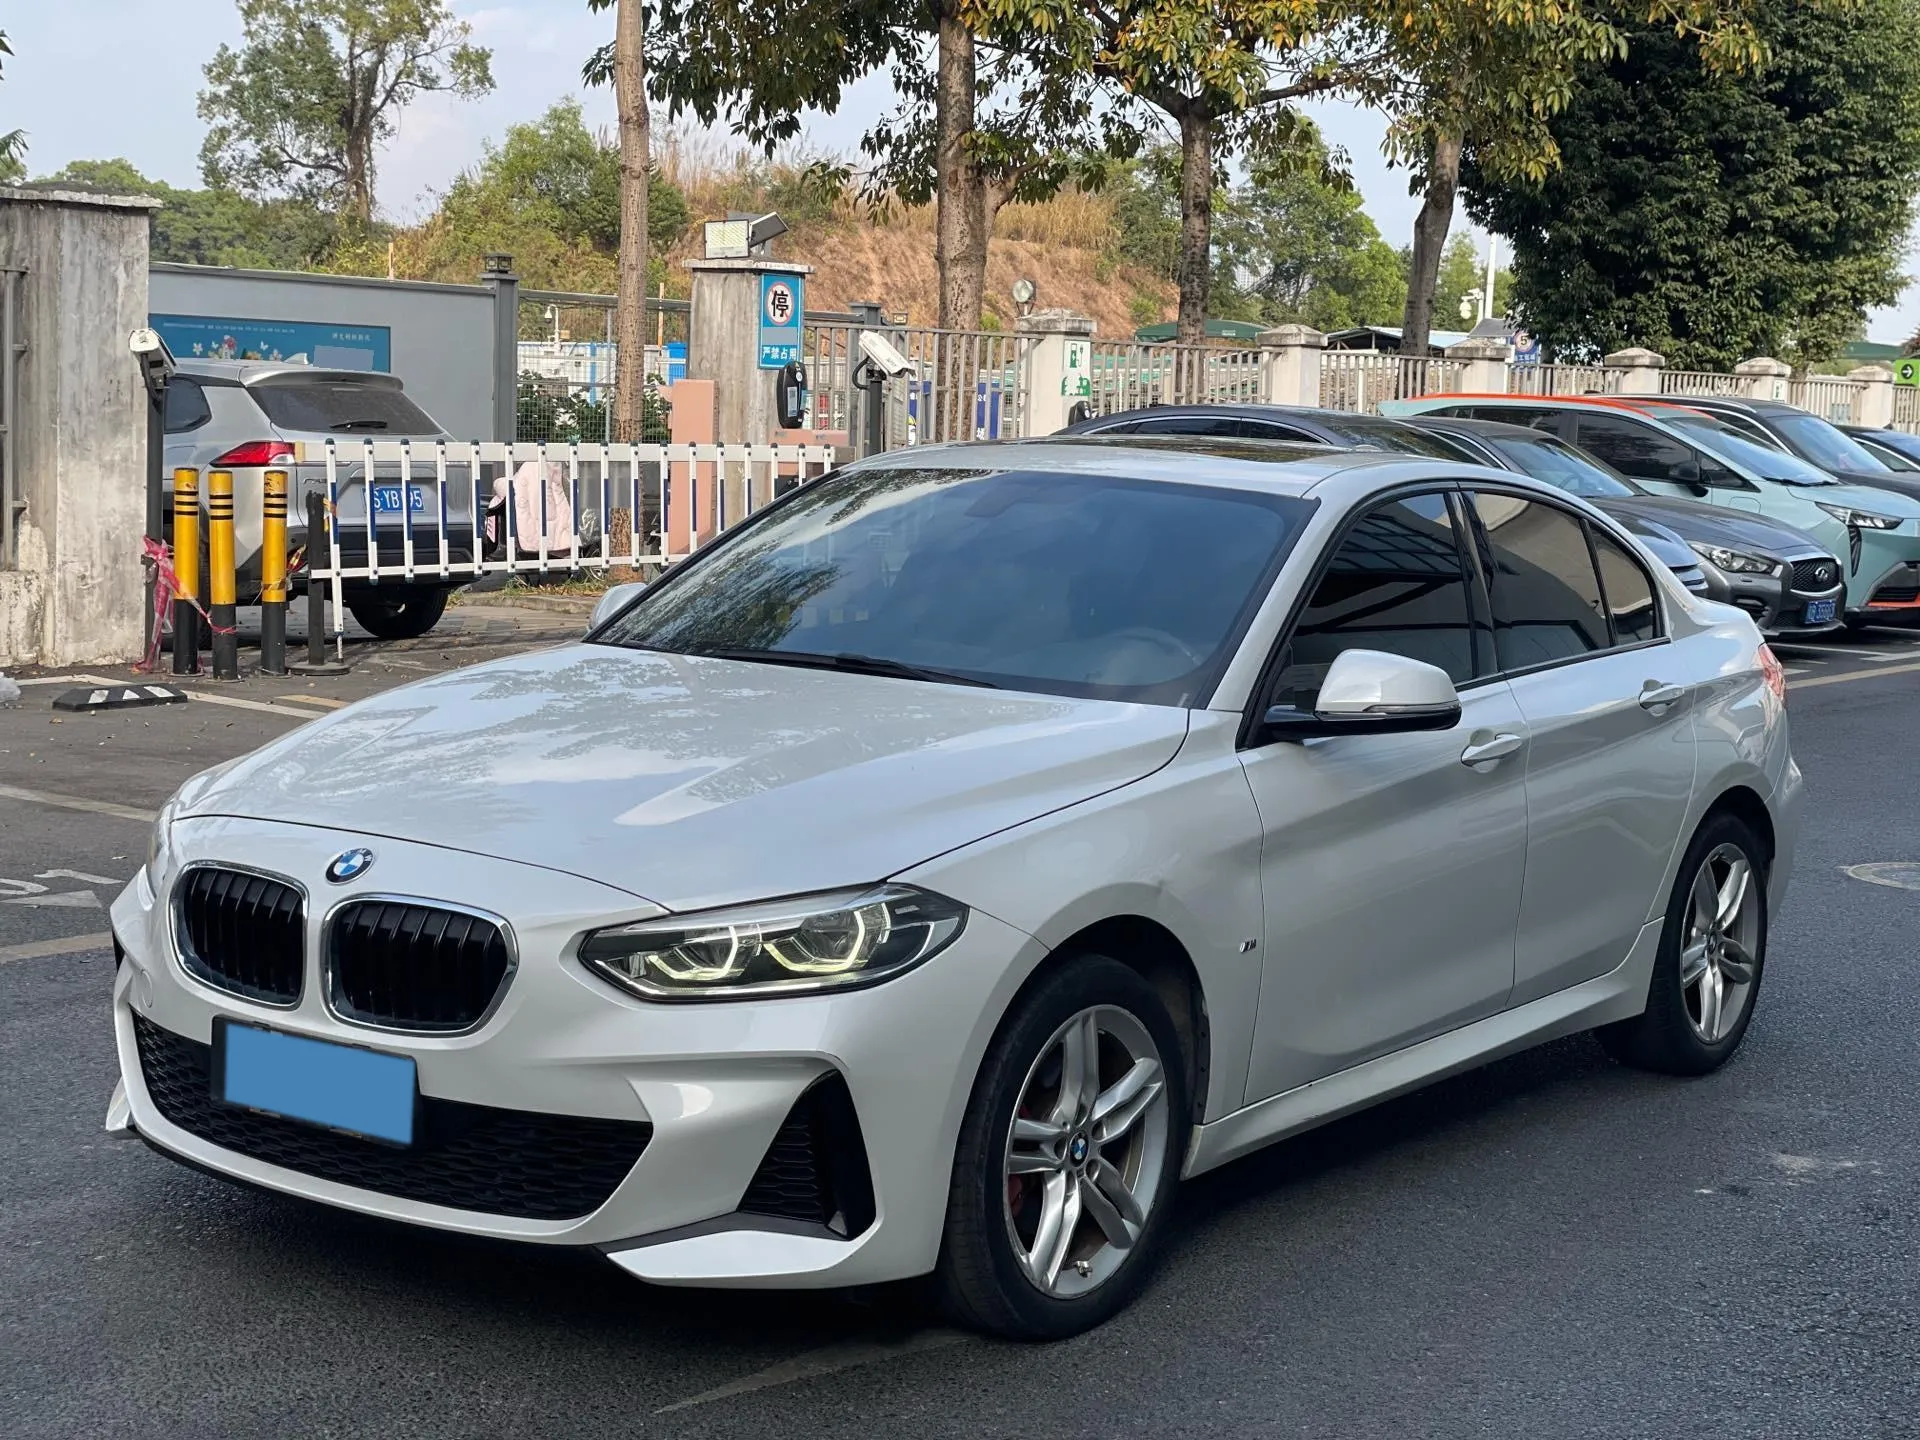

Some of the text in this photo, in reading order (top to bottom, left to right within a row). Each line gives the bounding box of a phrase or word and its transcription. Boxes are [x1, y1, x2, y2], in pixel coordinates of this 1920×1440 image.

[771, 290, 789, 317] 停
[1520, 335, 1529, 346] 5
[762, 346, 797, 361] 严禁占用
